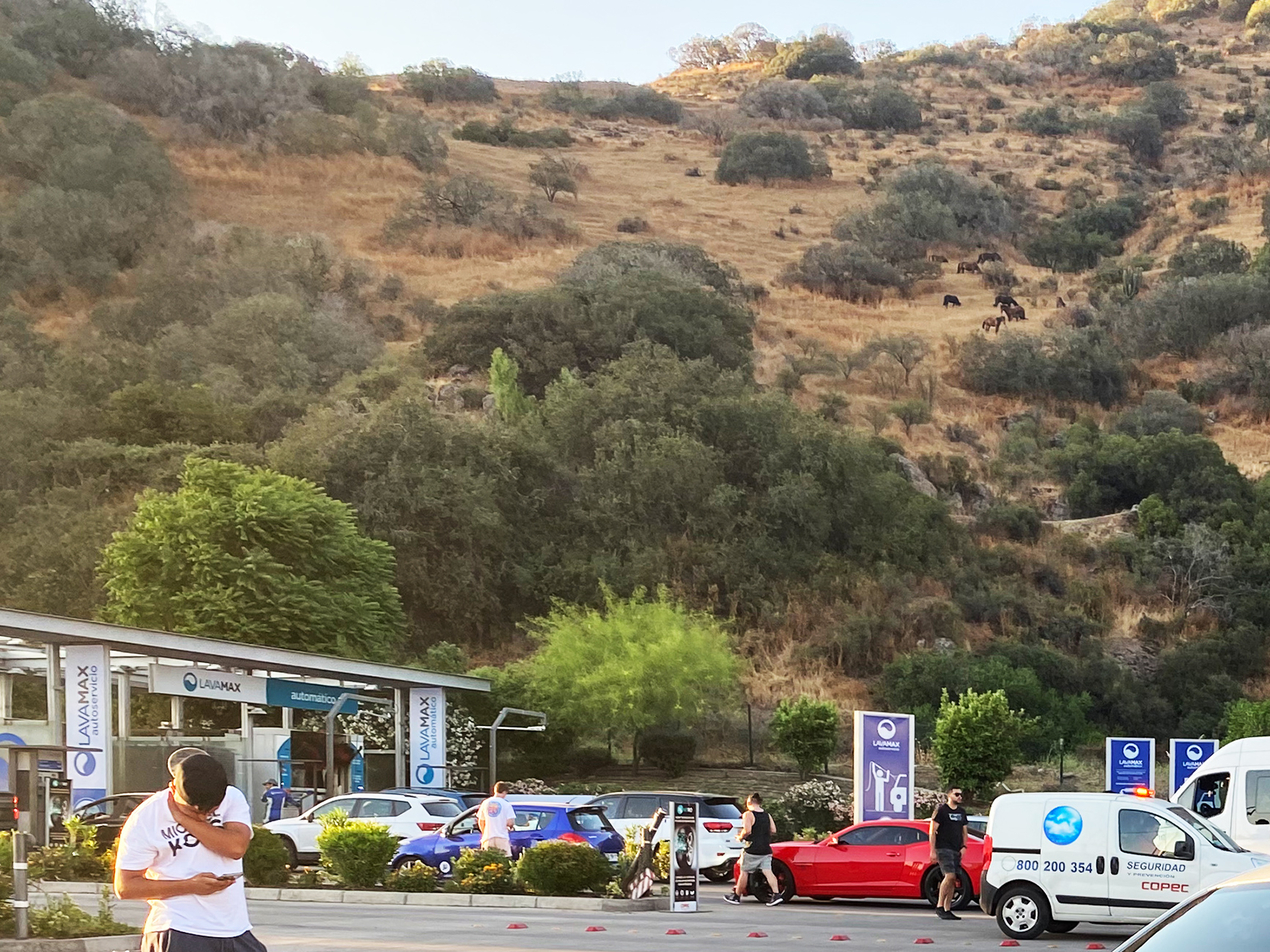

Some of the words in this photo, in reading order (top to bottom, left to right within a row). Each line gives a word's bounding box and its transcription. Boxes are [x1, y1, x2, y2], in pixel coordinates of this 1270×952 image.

[77, 665, 91, 746] LAVAMAX
[89, 665, 98, 736] autoservicio
[199, 680, 241, 693] LAVAMAX
[420, 696, 430, 760] LAVAMAX
[1016, 859, 1039, 871] 800
[1043, 860, 1066, 872] 200
[1070, 862, 1093, 874] 354
[1126, 861, 1186, 873] SEGURIDAD
